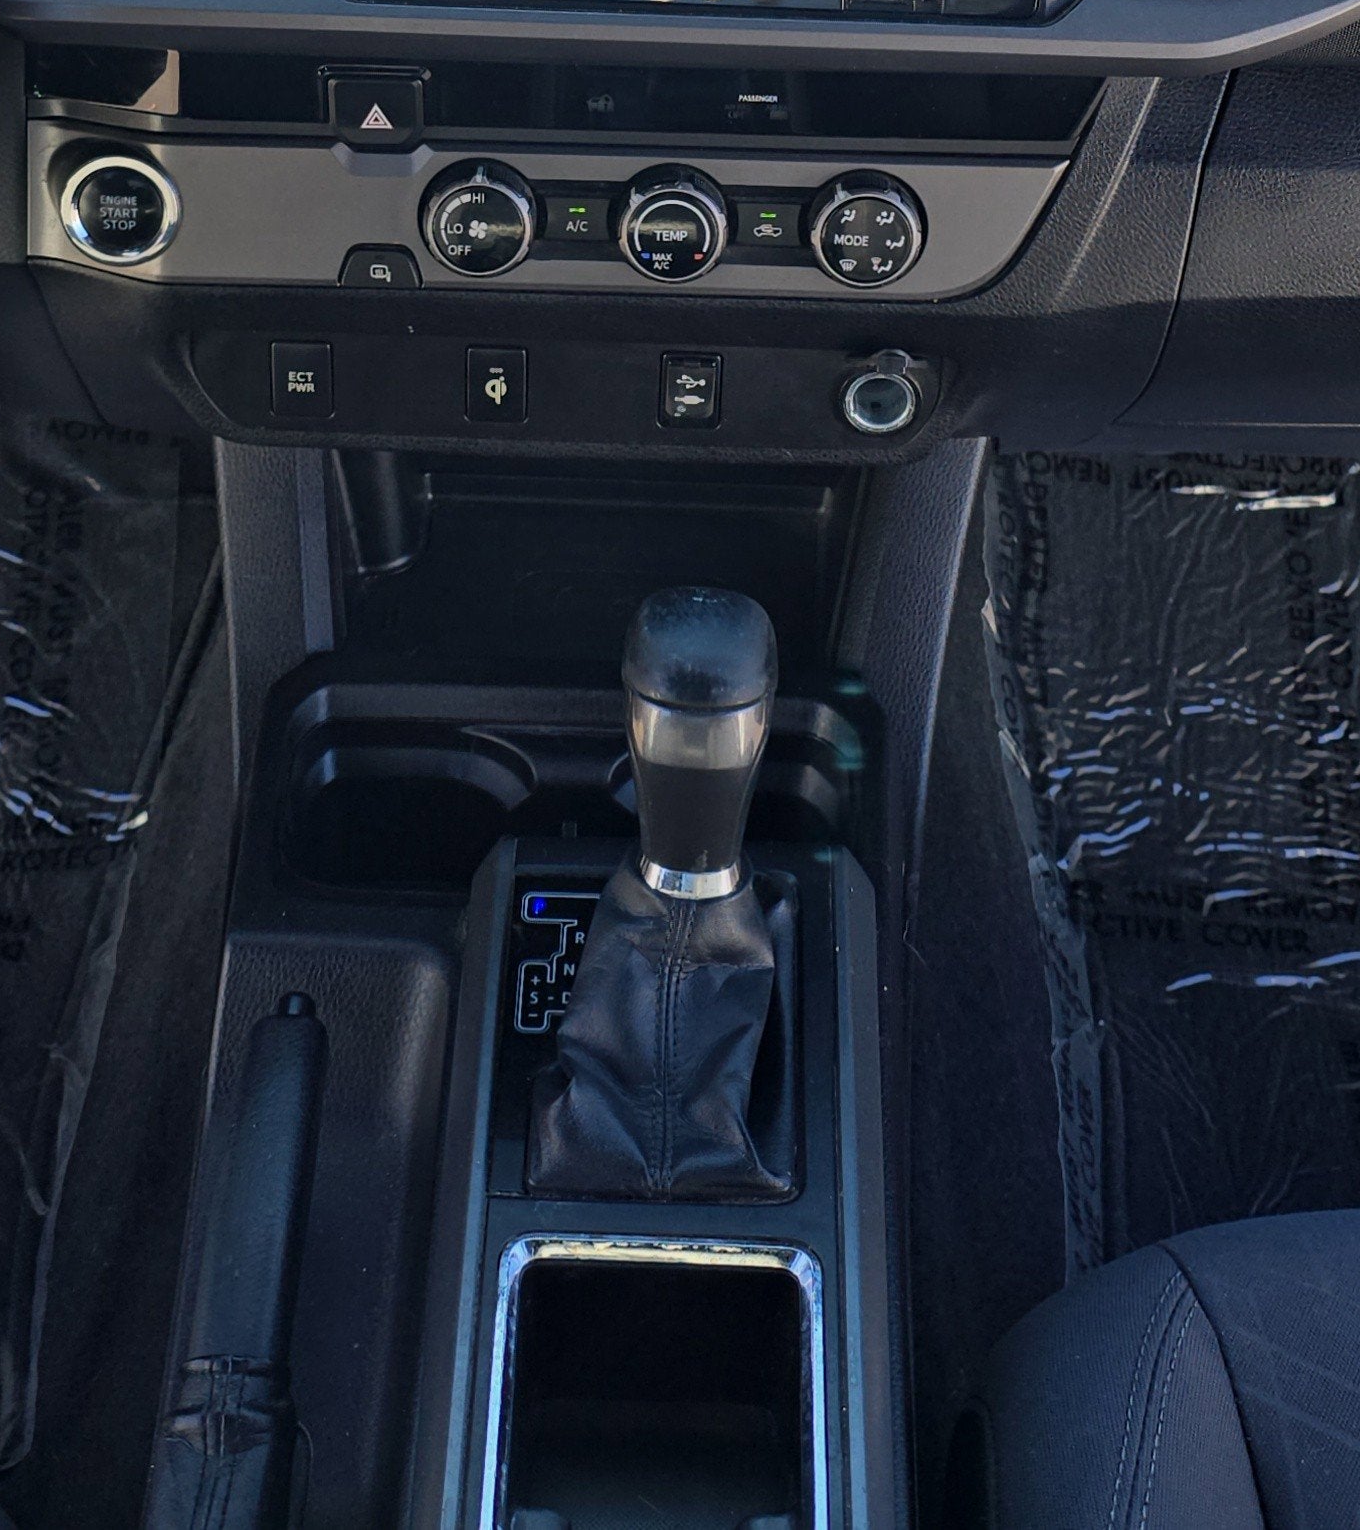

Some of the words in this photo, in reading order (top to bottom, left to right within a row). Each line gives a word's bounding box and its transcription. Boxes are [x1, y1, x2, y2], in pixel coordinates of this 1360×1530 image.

[738, 94, 778, 104] PASSENGER
[100, 195, 138, 205] ENGINE
[471, 193, 485, 204] HI
[100, 207, 139, 218] START
[103, 219, 137, 230] STOP
[447, 223, 464, 234] LO
[566, 220, 589, 232] A/C
[653, 230, 688, 242] TEMP
[833, 233, 870, 247] MODE
[447, 244, 472, 256] OFF
[651, 252, 673, 262] MAX
[653, 261, 670, 270] A/C
[288, 370, 315, 382] ECT
[287, 381, 315, 393] PWR
[573, 931, 586, 944] R
[1202, 921, 1309, 952] COVER
[563, 963, 576, 976] N
[529, 991, 539, 1005] S
